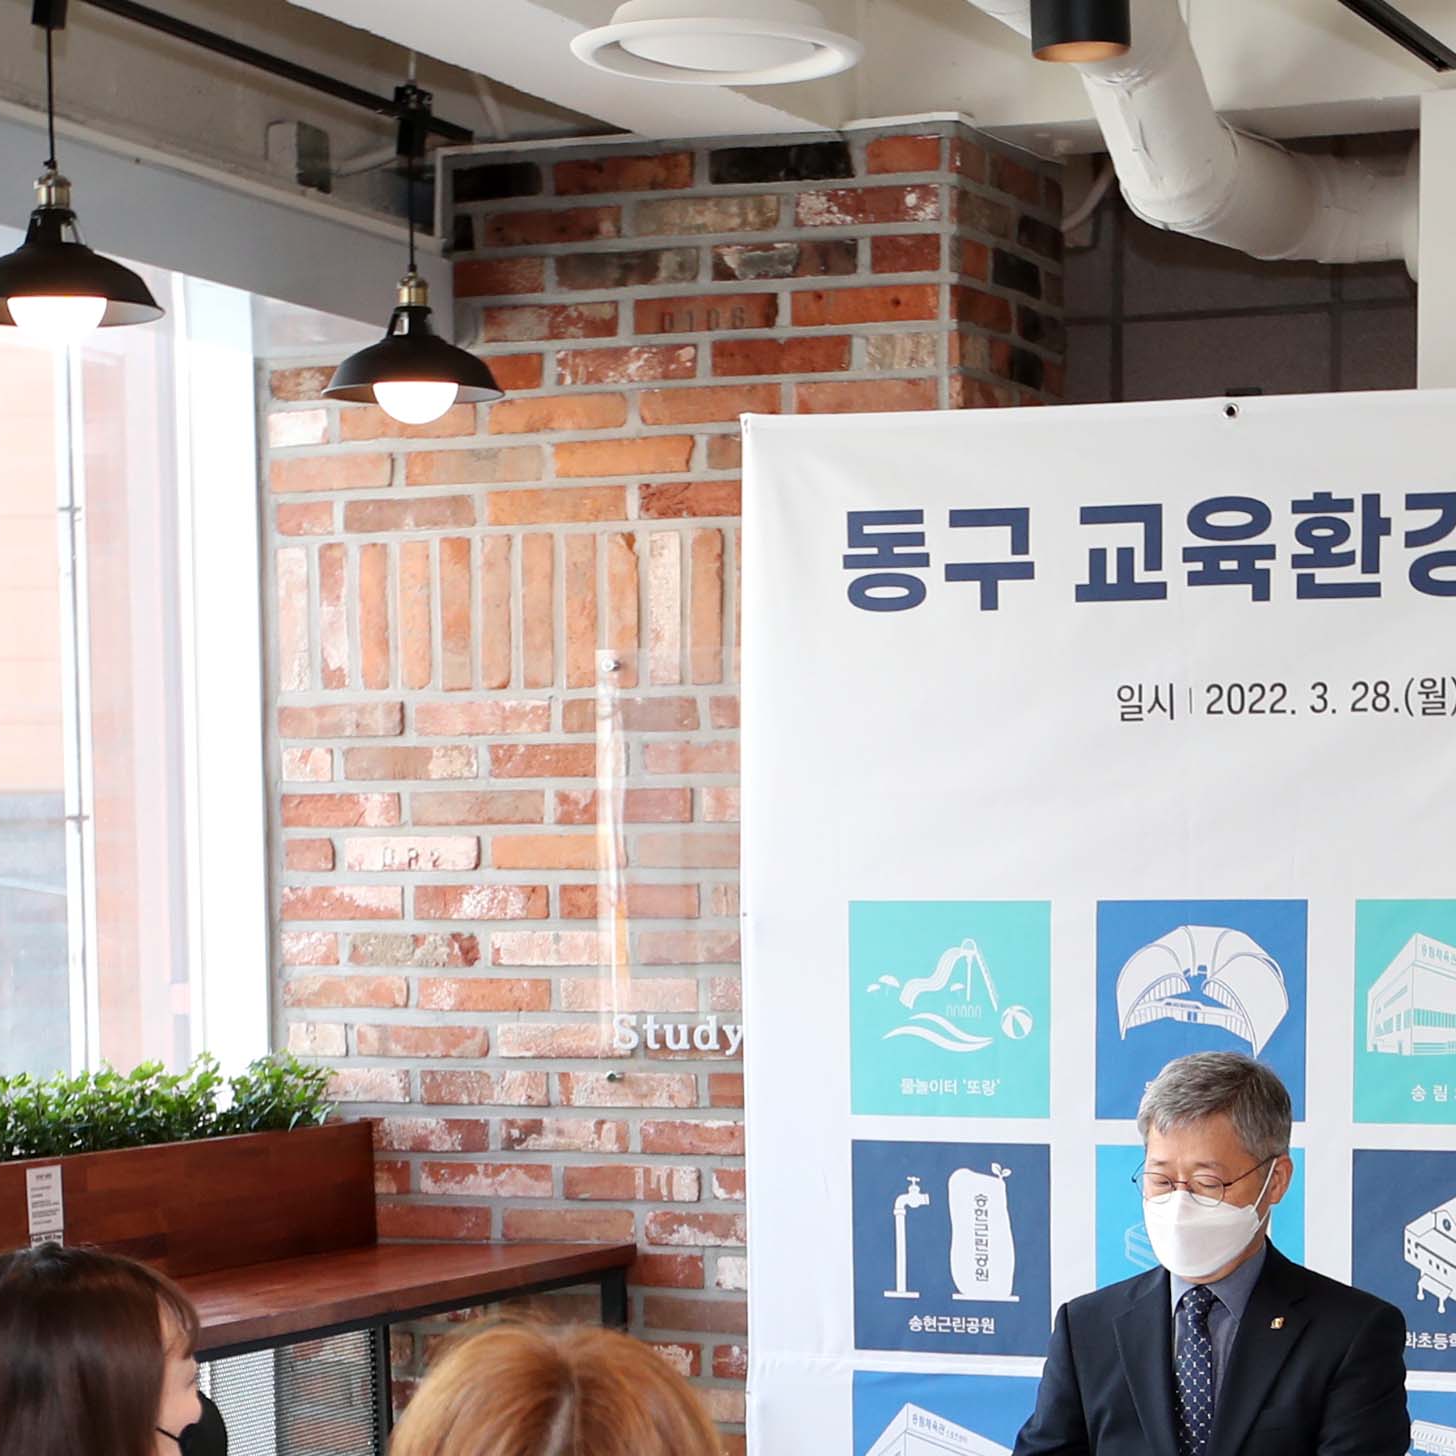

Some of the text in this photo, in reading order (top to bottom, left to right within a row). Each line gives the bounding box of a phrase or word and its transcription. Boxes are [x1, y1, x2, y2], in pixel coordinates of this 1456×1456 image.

[842, 506, 1036, 612] 동구
[1116, 682, 1175, 722] 일시
[1205, 682, 1296, 715] 2022.
[1309, 681, 1337, 715] 3.
[612, 1014, 744, 1056] Study
[900, 1077, 958, 1096] 물놀이터
[908, 1314, 995, 1335] 송현근린공원
